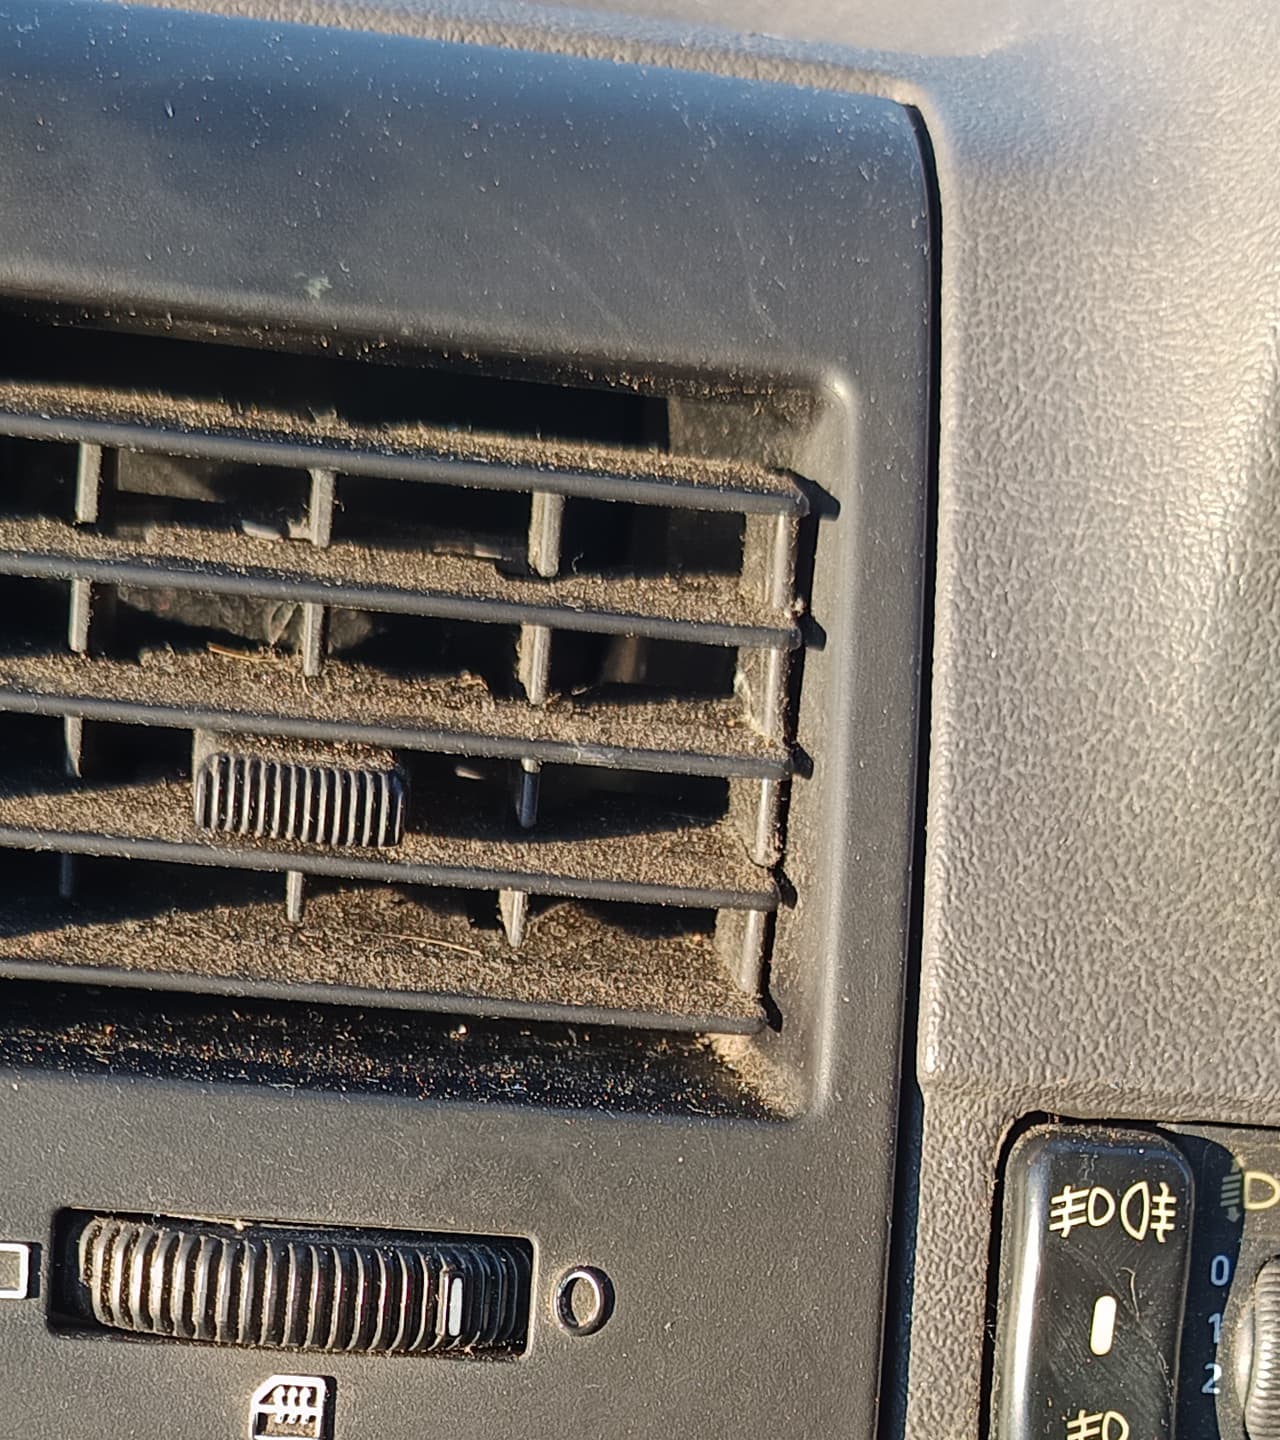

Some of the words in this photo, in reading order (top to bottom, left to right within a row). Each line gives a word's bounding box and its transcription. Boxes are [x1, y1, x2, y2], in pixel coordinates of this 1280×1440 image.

[1210, 1255, 1230, 1286] 0
[1208, 1314, 1222, 1344] 1
[1201, 1365, 1222, 1395] 2
